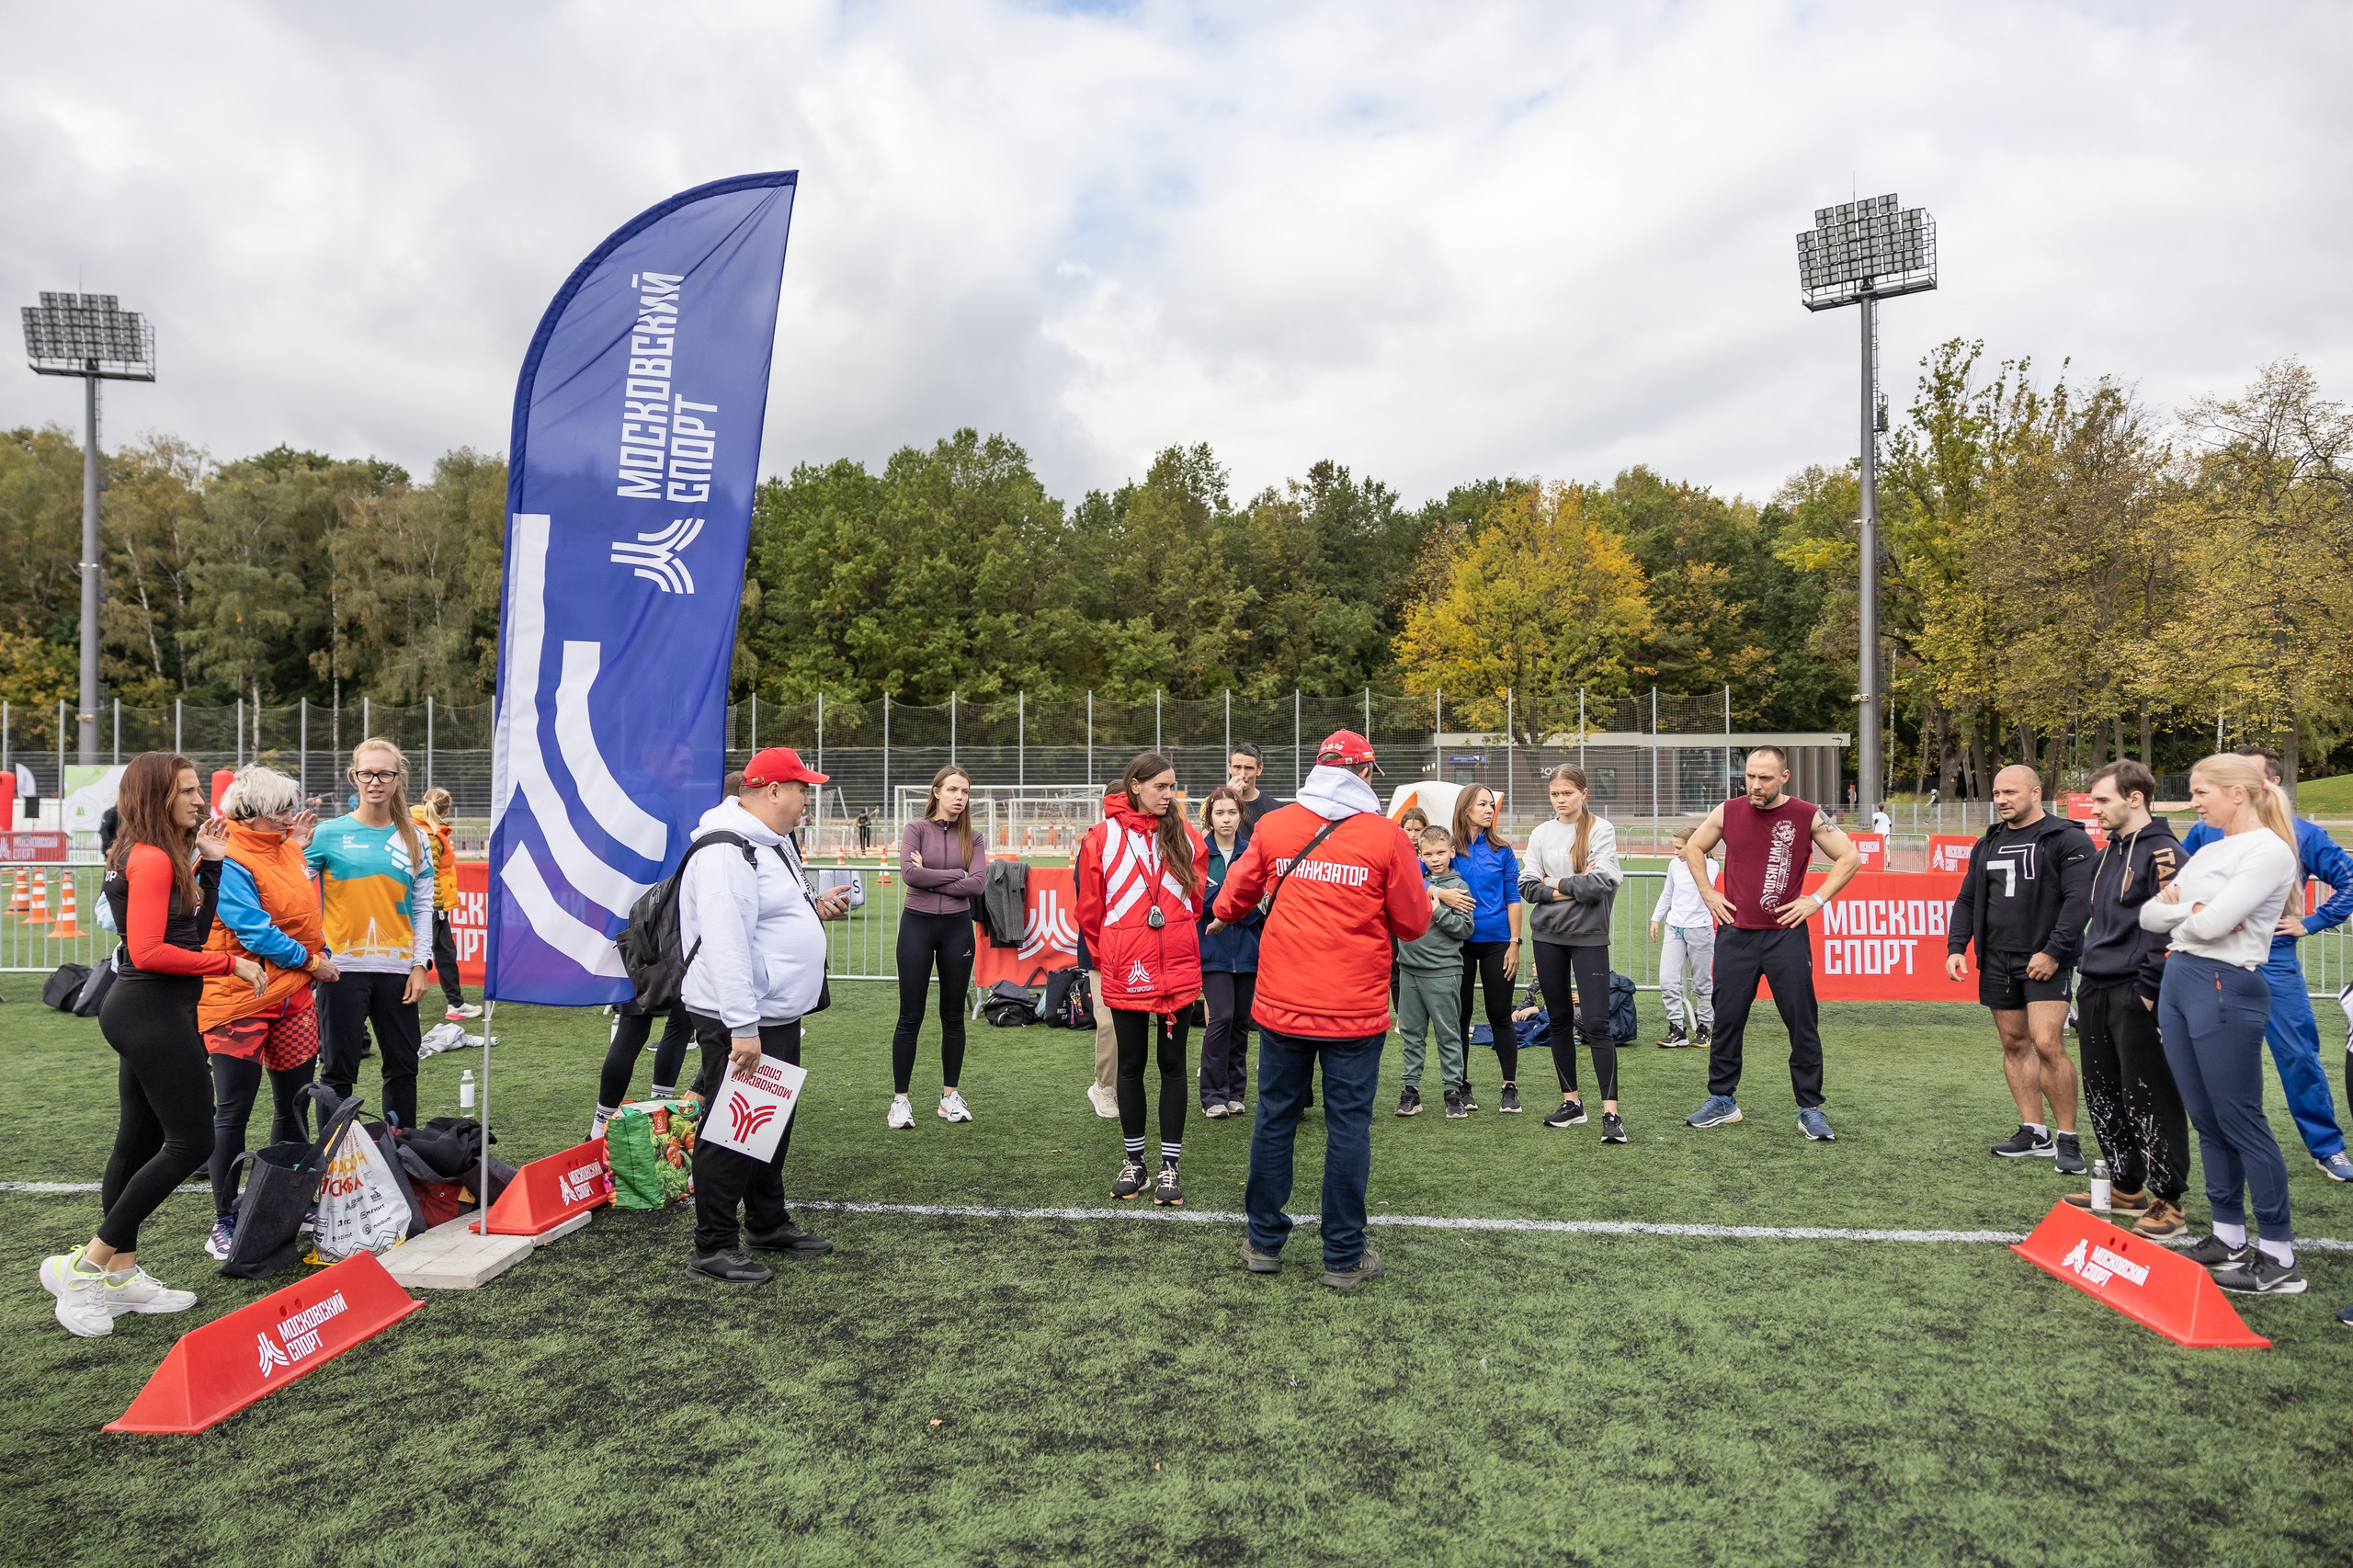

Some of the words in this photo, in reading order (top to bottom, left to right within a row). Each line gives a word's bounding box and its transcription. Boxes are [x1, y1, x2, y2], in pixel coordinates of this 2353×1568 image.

[617, 272, 685, 500] МОСКОВСКИЙ
[666, 393, 718, 503] СПОРТ
[1768, 840, 1783, 863] PWR
[1824, 939, 1918, 974] СПОРТ
[755, 1064, 782, 1081] СПОР
[567, 1158, 604, 1186] МОСКОВСКИЙ
[574, 1181, 594, 1200] СПОРТ
[2080, 1261, 2113, 1287] СПОРТ
[2090, 1244, 2151, 1287] МОСКОВСКИЙ
[277, 1289, 348, 1343] МОСКОВСКИЙ
[285, 1328, 324, 1362] СПОРТ
